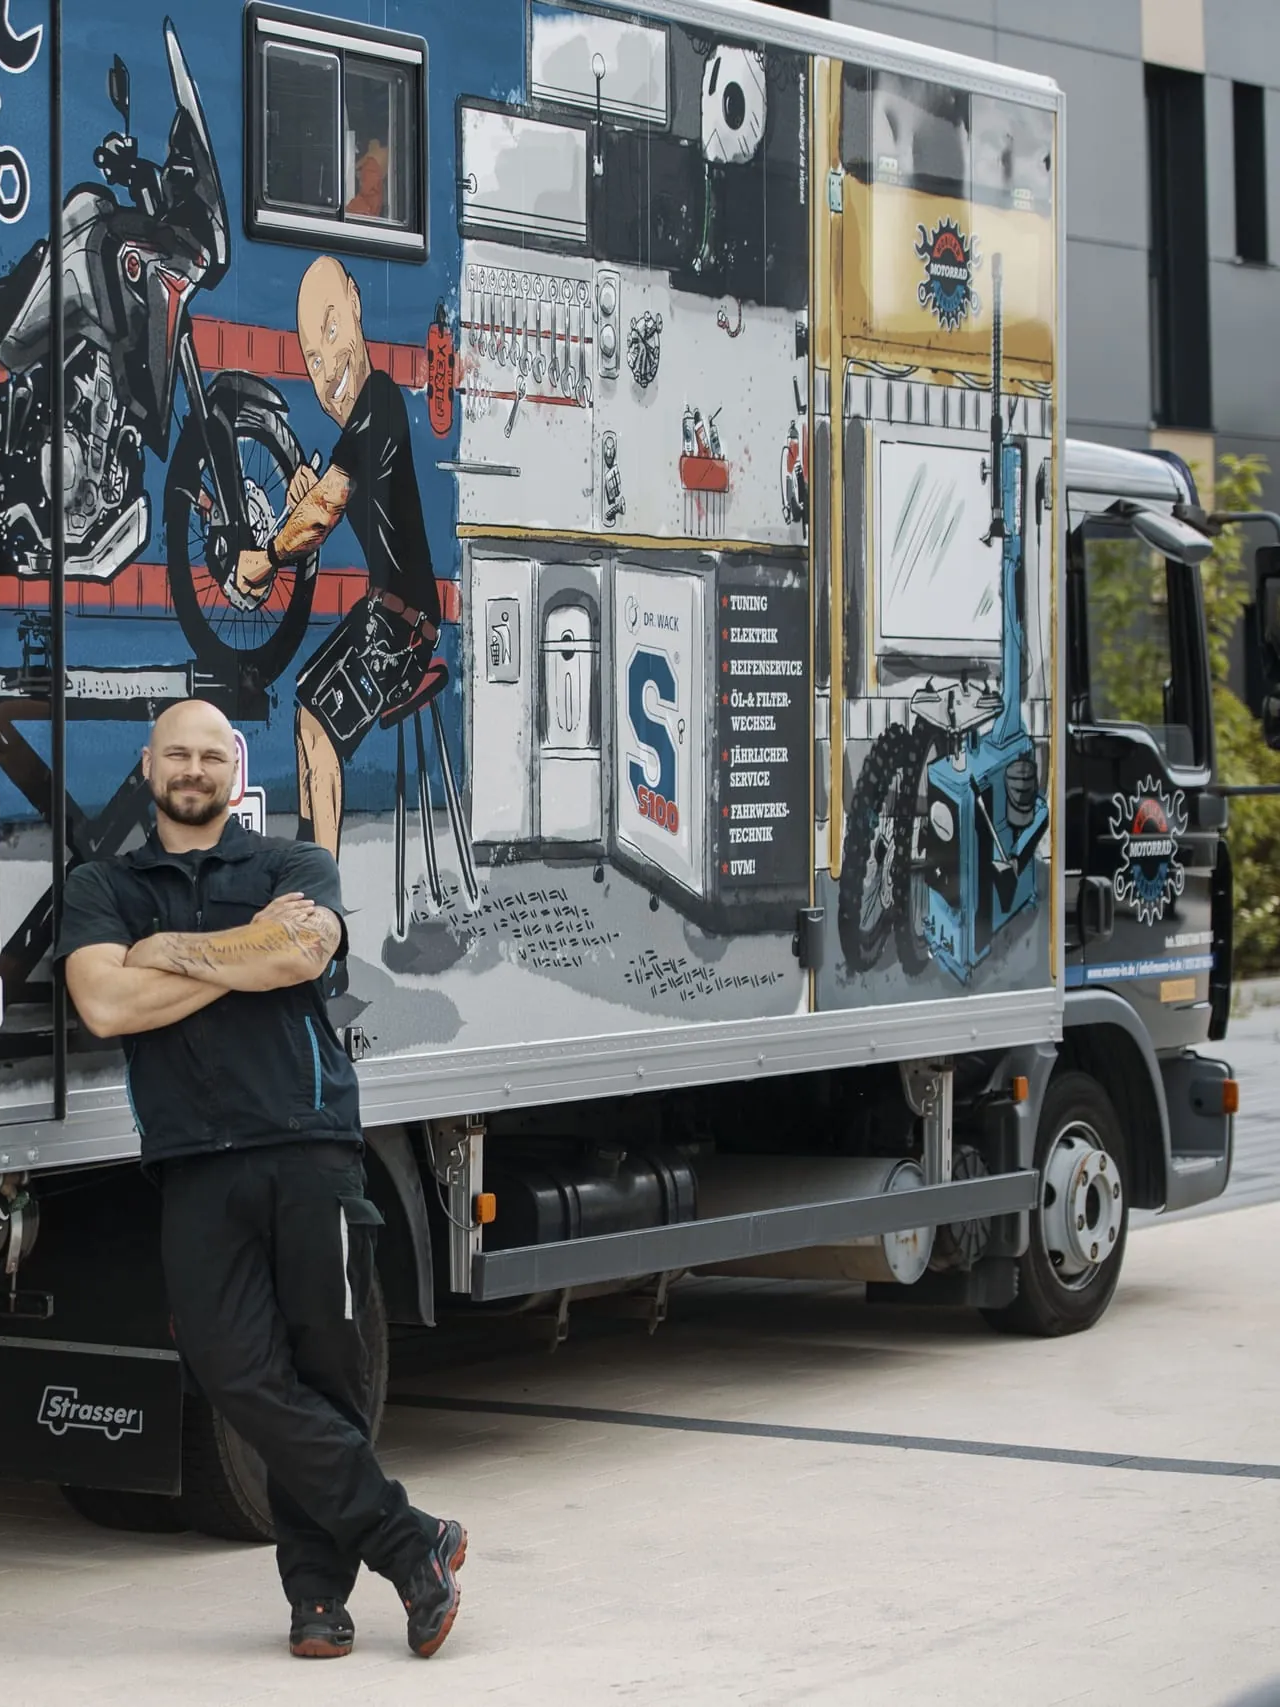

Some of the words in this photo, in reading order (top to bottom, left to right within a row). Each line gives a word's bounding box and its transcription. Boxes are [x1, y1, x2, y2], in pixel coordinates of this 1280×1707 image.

[930, 263, 969, 280] MOTORRAD
[730, 595, 768, 611] TUNING
[644, 611, 656, 627] DR.
[657, 613, 680, 632] WACK
[730, 627, 778, 644] ELEKTRIK
[730, 659, 802, 676] REIFENSERVICE
[756, 692, 792, 707] FILTER-
[731, 716, 776, 732] WECHSEL
[730, 744, 788, 767] JÄHRLICHER
[730, 771, 770, 787] SERVICE
[637, 784, 680, 835] S100
[731, 803, 790, 820] FAHRWERKS-
[729, 826, 773, 844] TECHNIK
[1129, 839, 1171, 858] MOTORRAD
[731, 859, 756, 876] UVM!
[47, 1395, 138, 1425] Strasser
